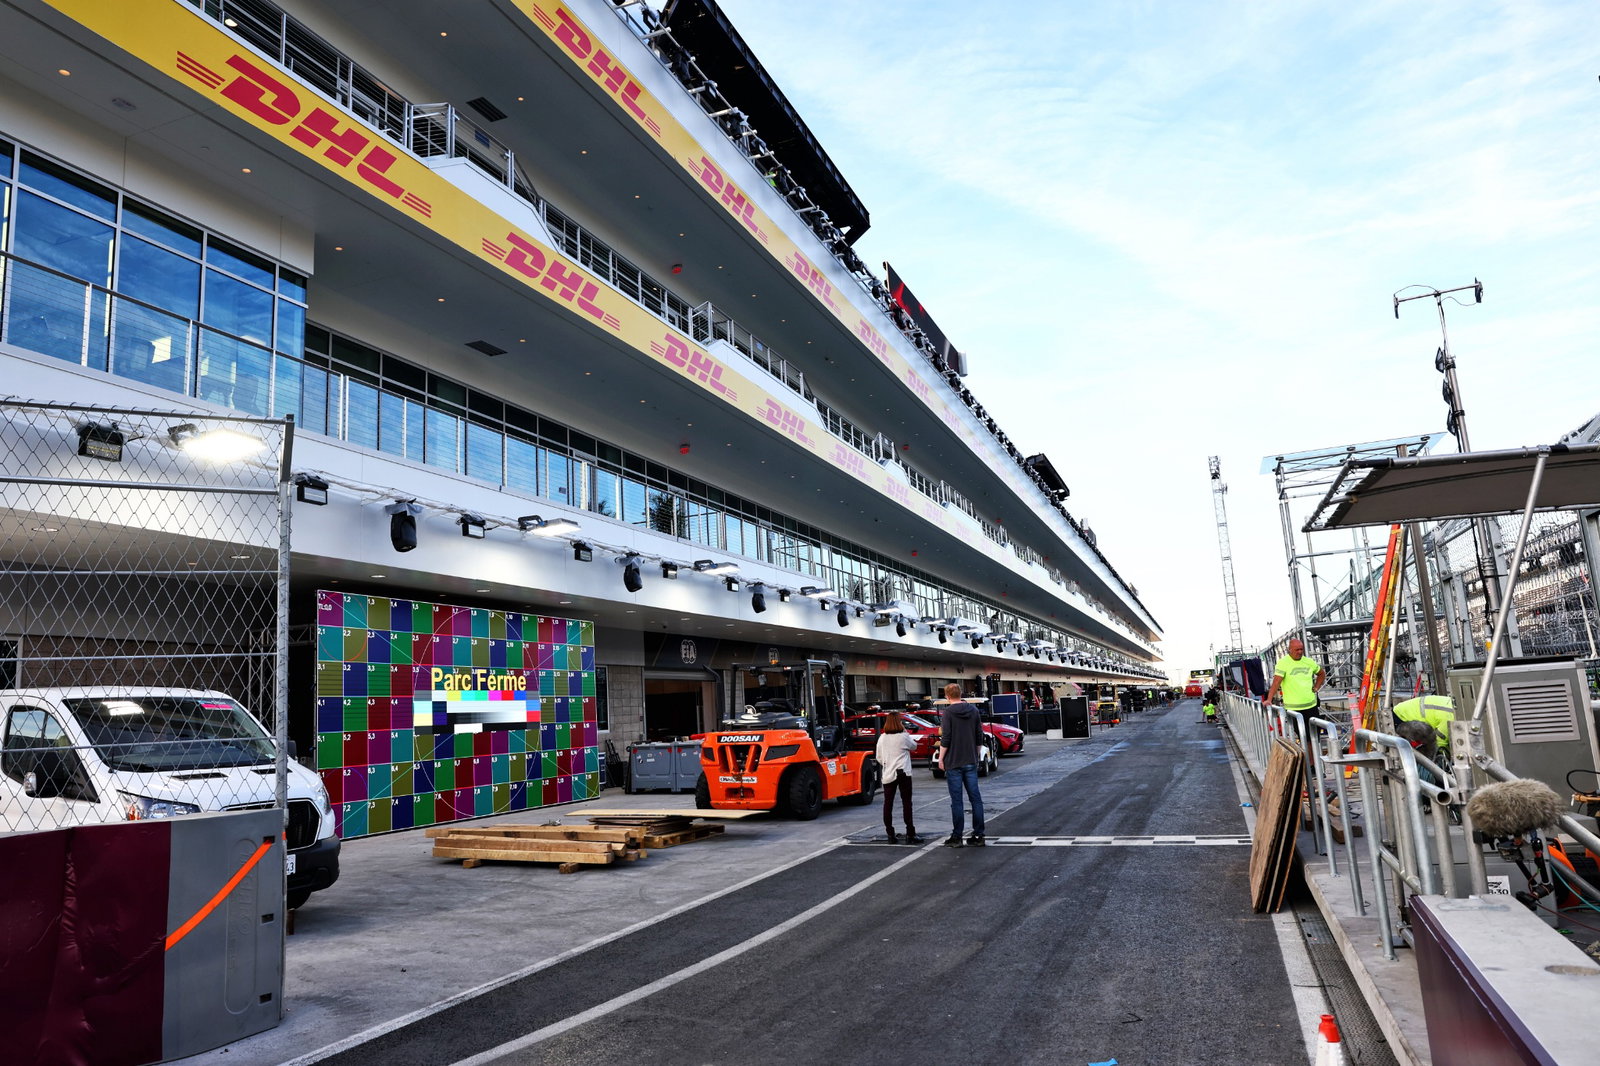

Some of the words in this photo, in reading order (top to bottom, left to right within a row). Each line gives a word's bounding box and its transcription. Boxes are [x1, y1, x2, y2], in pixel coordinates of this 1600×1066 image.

[554, 8, 646, 120] DHL
[220, 54, 404, 199] DHL
[700, 156, 758, 233] DHL
[504, 232, 605, 320] DHL
[794, 252, 835, 308] DHL
[664, 333, 727, 394] DHL
[859, 319, 889, 363] DHL
[906, 368, 931, 404] DHL
[766, 398, 809, 443] DHL
[835, 444, 866, 479] DHL
[886, 476, 911, 506] DHL
[431, 667, 471, 690] Parc
[477, 669, 526, 691] Ferme
